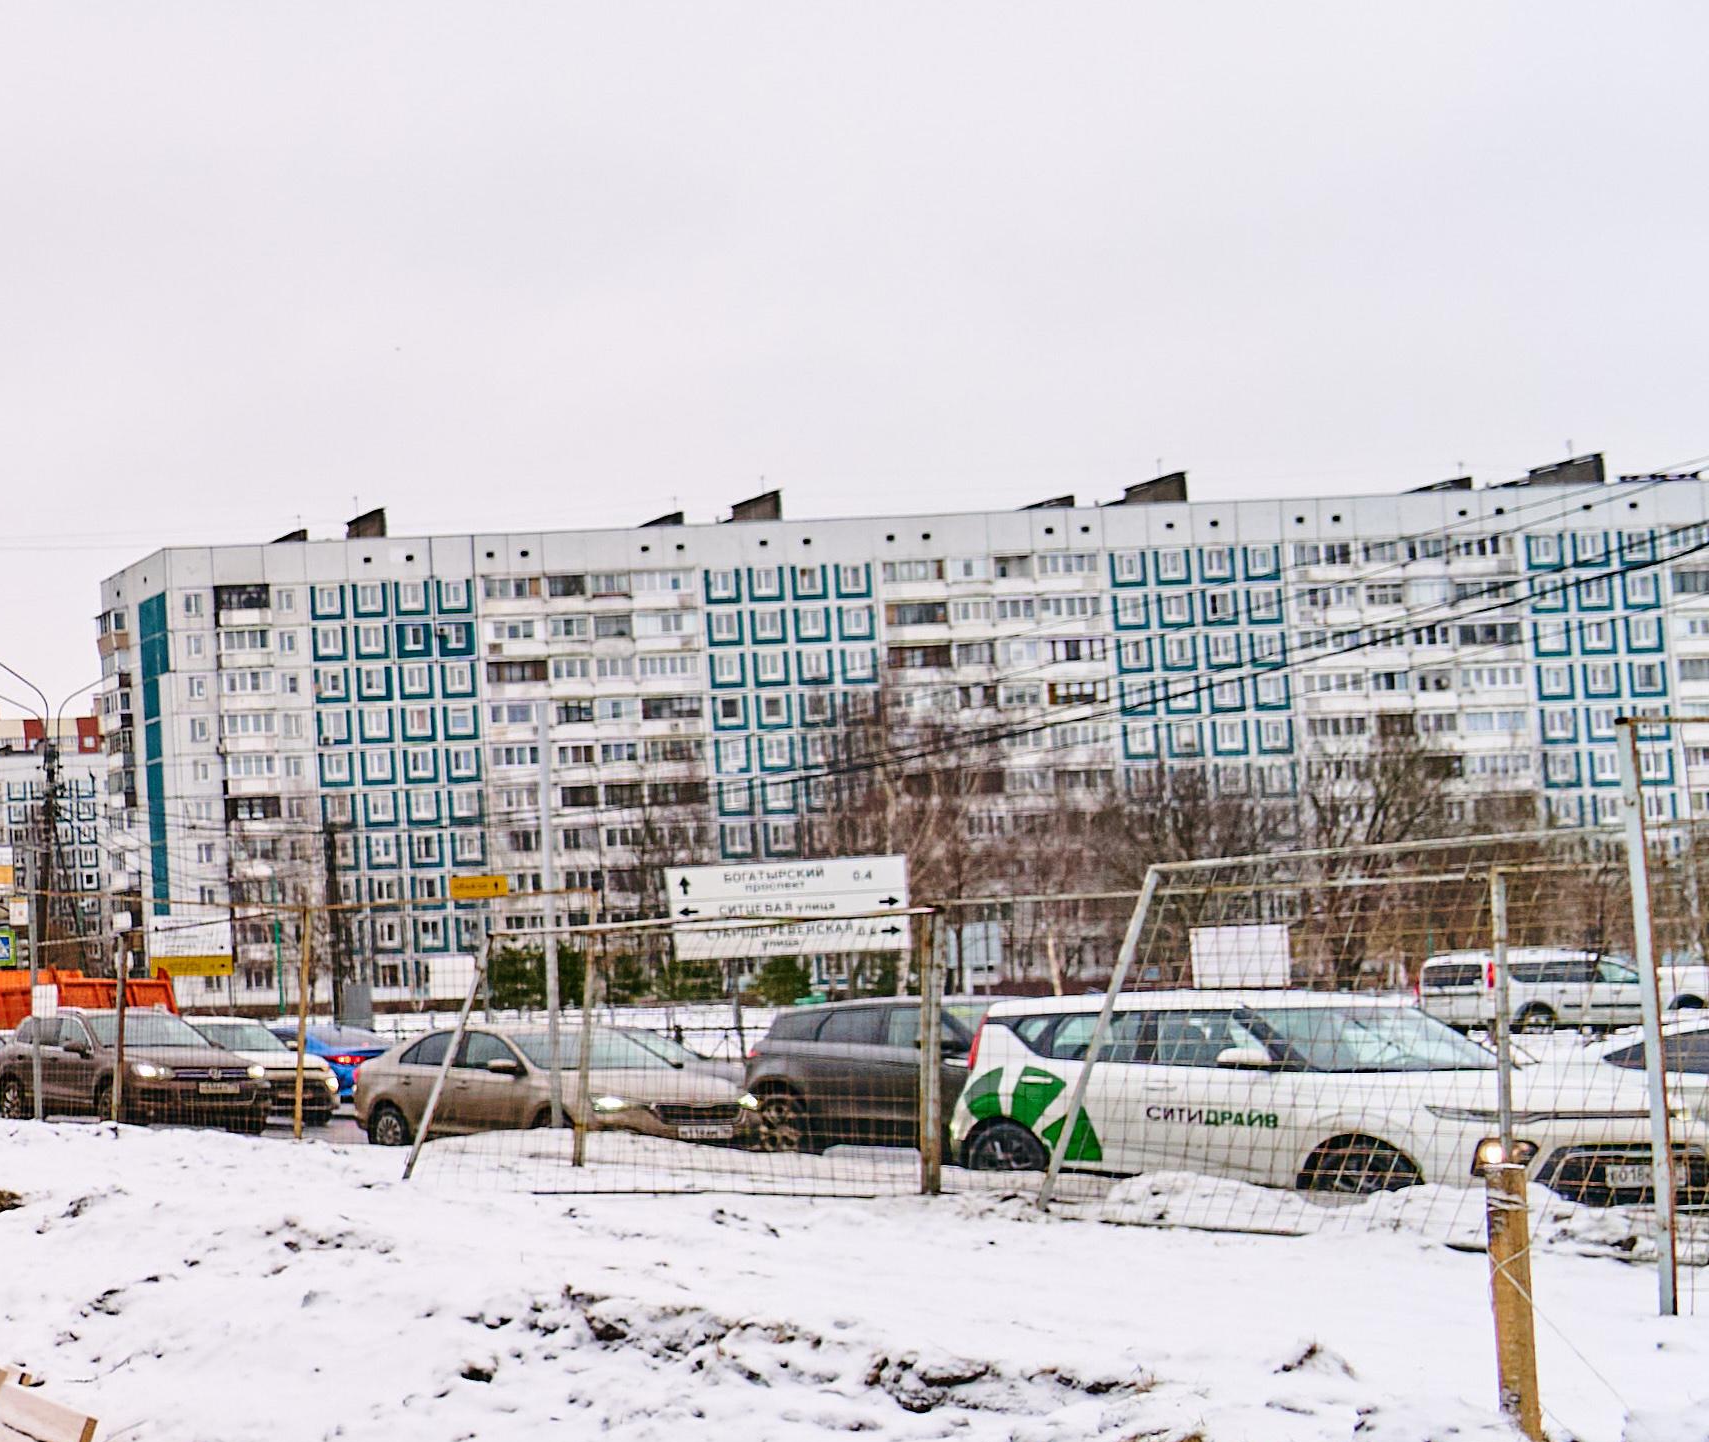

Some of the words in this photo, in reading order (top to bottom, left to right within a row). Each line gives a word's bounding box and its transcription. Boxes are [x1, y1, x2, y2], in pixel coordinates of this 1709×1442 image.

[723, 866, 825, 884] БОГАТЫРСКИЙ
[744, 881, 806, 893] проспект
[718, 901, 794, 917] СИТЦЕВАЯ
[797, 902, 836, 914] улица
[761, 939, 800, 951] улица
[1145, 1105, 1279, 1129] СИТИДРАЙВ
